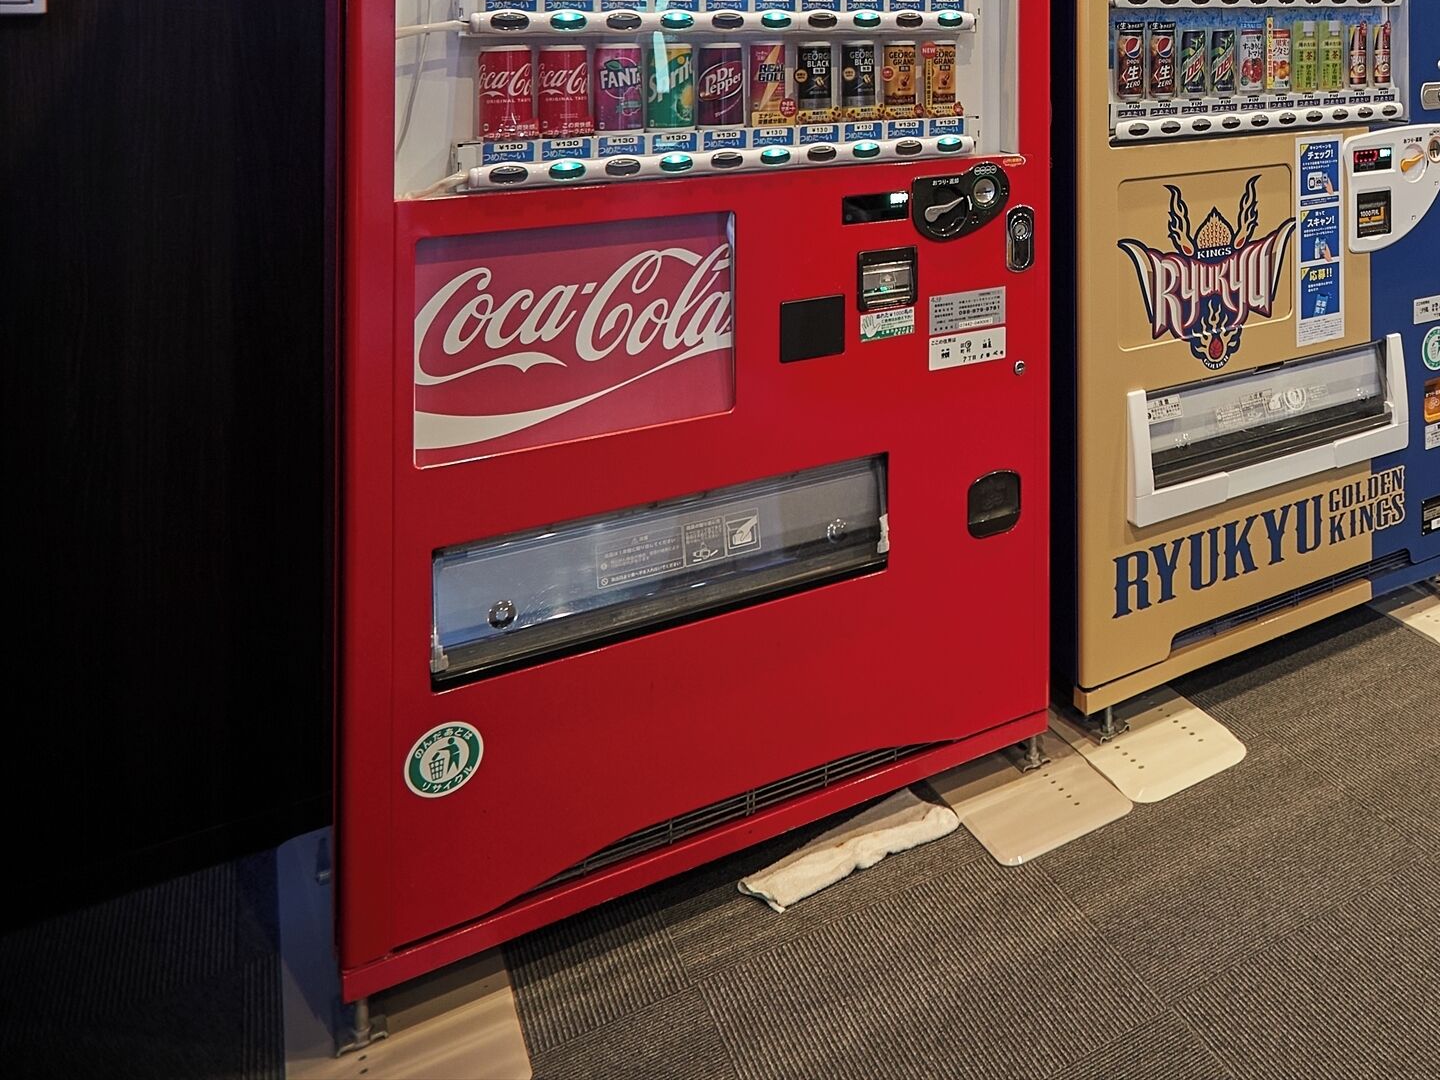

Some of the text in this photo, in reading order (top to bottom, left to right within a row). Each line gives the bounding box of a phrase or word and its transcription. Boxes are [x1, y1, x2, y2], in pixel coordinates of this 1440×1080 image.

[716, 67, 734, 81] Dr
[1127, 65, 1139, 81] 生
[1159, 65, 1171, 81] 生
[704, 72, 741, 96] Pepper
[499, 143, 523, 151] ¥130
[1307, 216, 1334, 227] スキャン!
[1197, 246, 1232, 259] KINGS
[415, 244, 733, 386] Coca-Cola
[1203, 356, 1229, 369] GOLDEN
[1329, 467, 1404, 512] GOLDEN
[1329, 495, 1405, 545] KINGS
[1112, 494, 1324, 619] RYUKYU
[414, 727, 474, 760] のんだあとは
[421, 764, 474, 793] リサイクル
